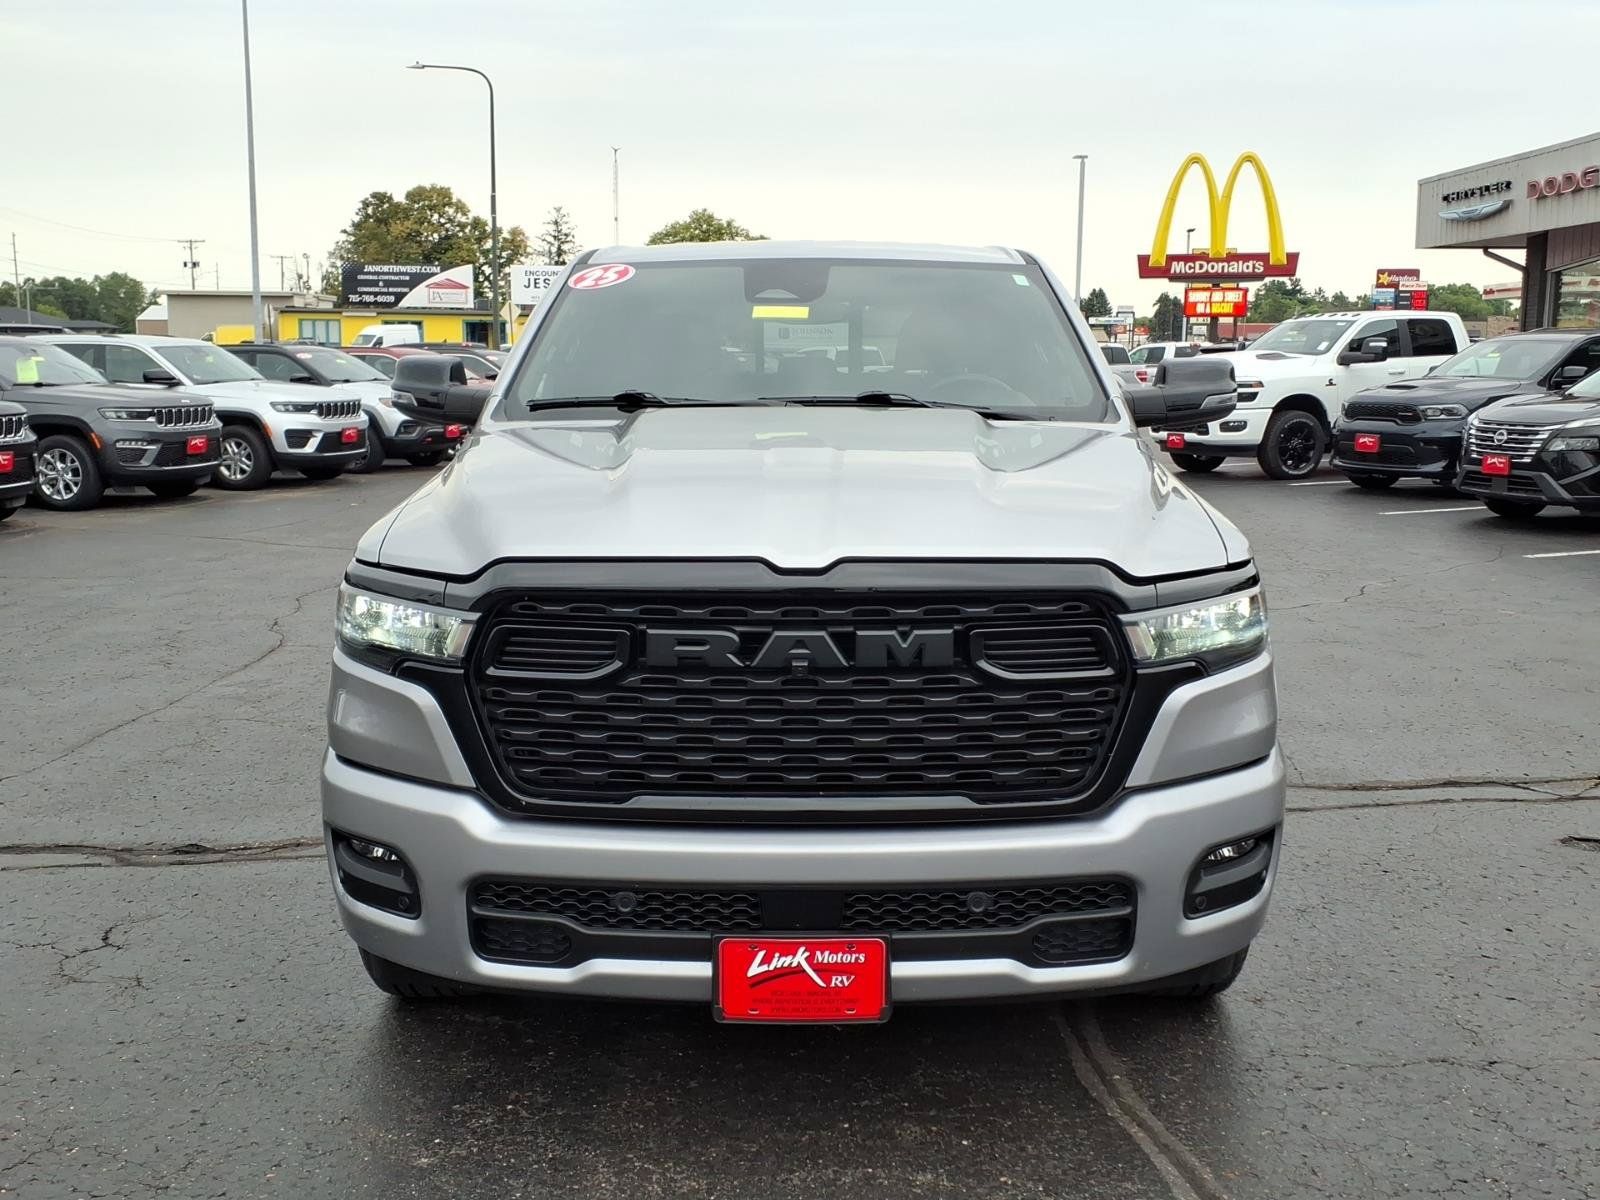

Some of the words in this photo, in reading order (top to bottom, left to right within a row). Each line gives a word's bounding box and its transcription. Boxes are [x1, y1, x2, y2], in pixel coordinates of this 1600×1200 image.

[1442, 180, 1513, 203] CHRYSLER
[363, 264, 441, 274] JANORTHWEST.COM
[575, 265, 625, 288] 25
[1170, 260, 1264, 274] McDonald's
[646, 628, 955, 668] RAM
[747, 946, 827, 988] Link
[813, 950, 866, 964] Motors
[829, 975, 856, 988] RV
